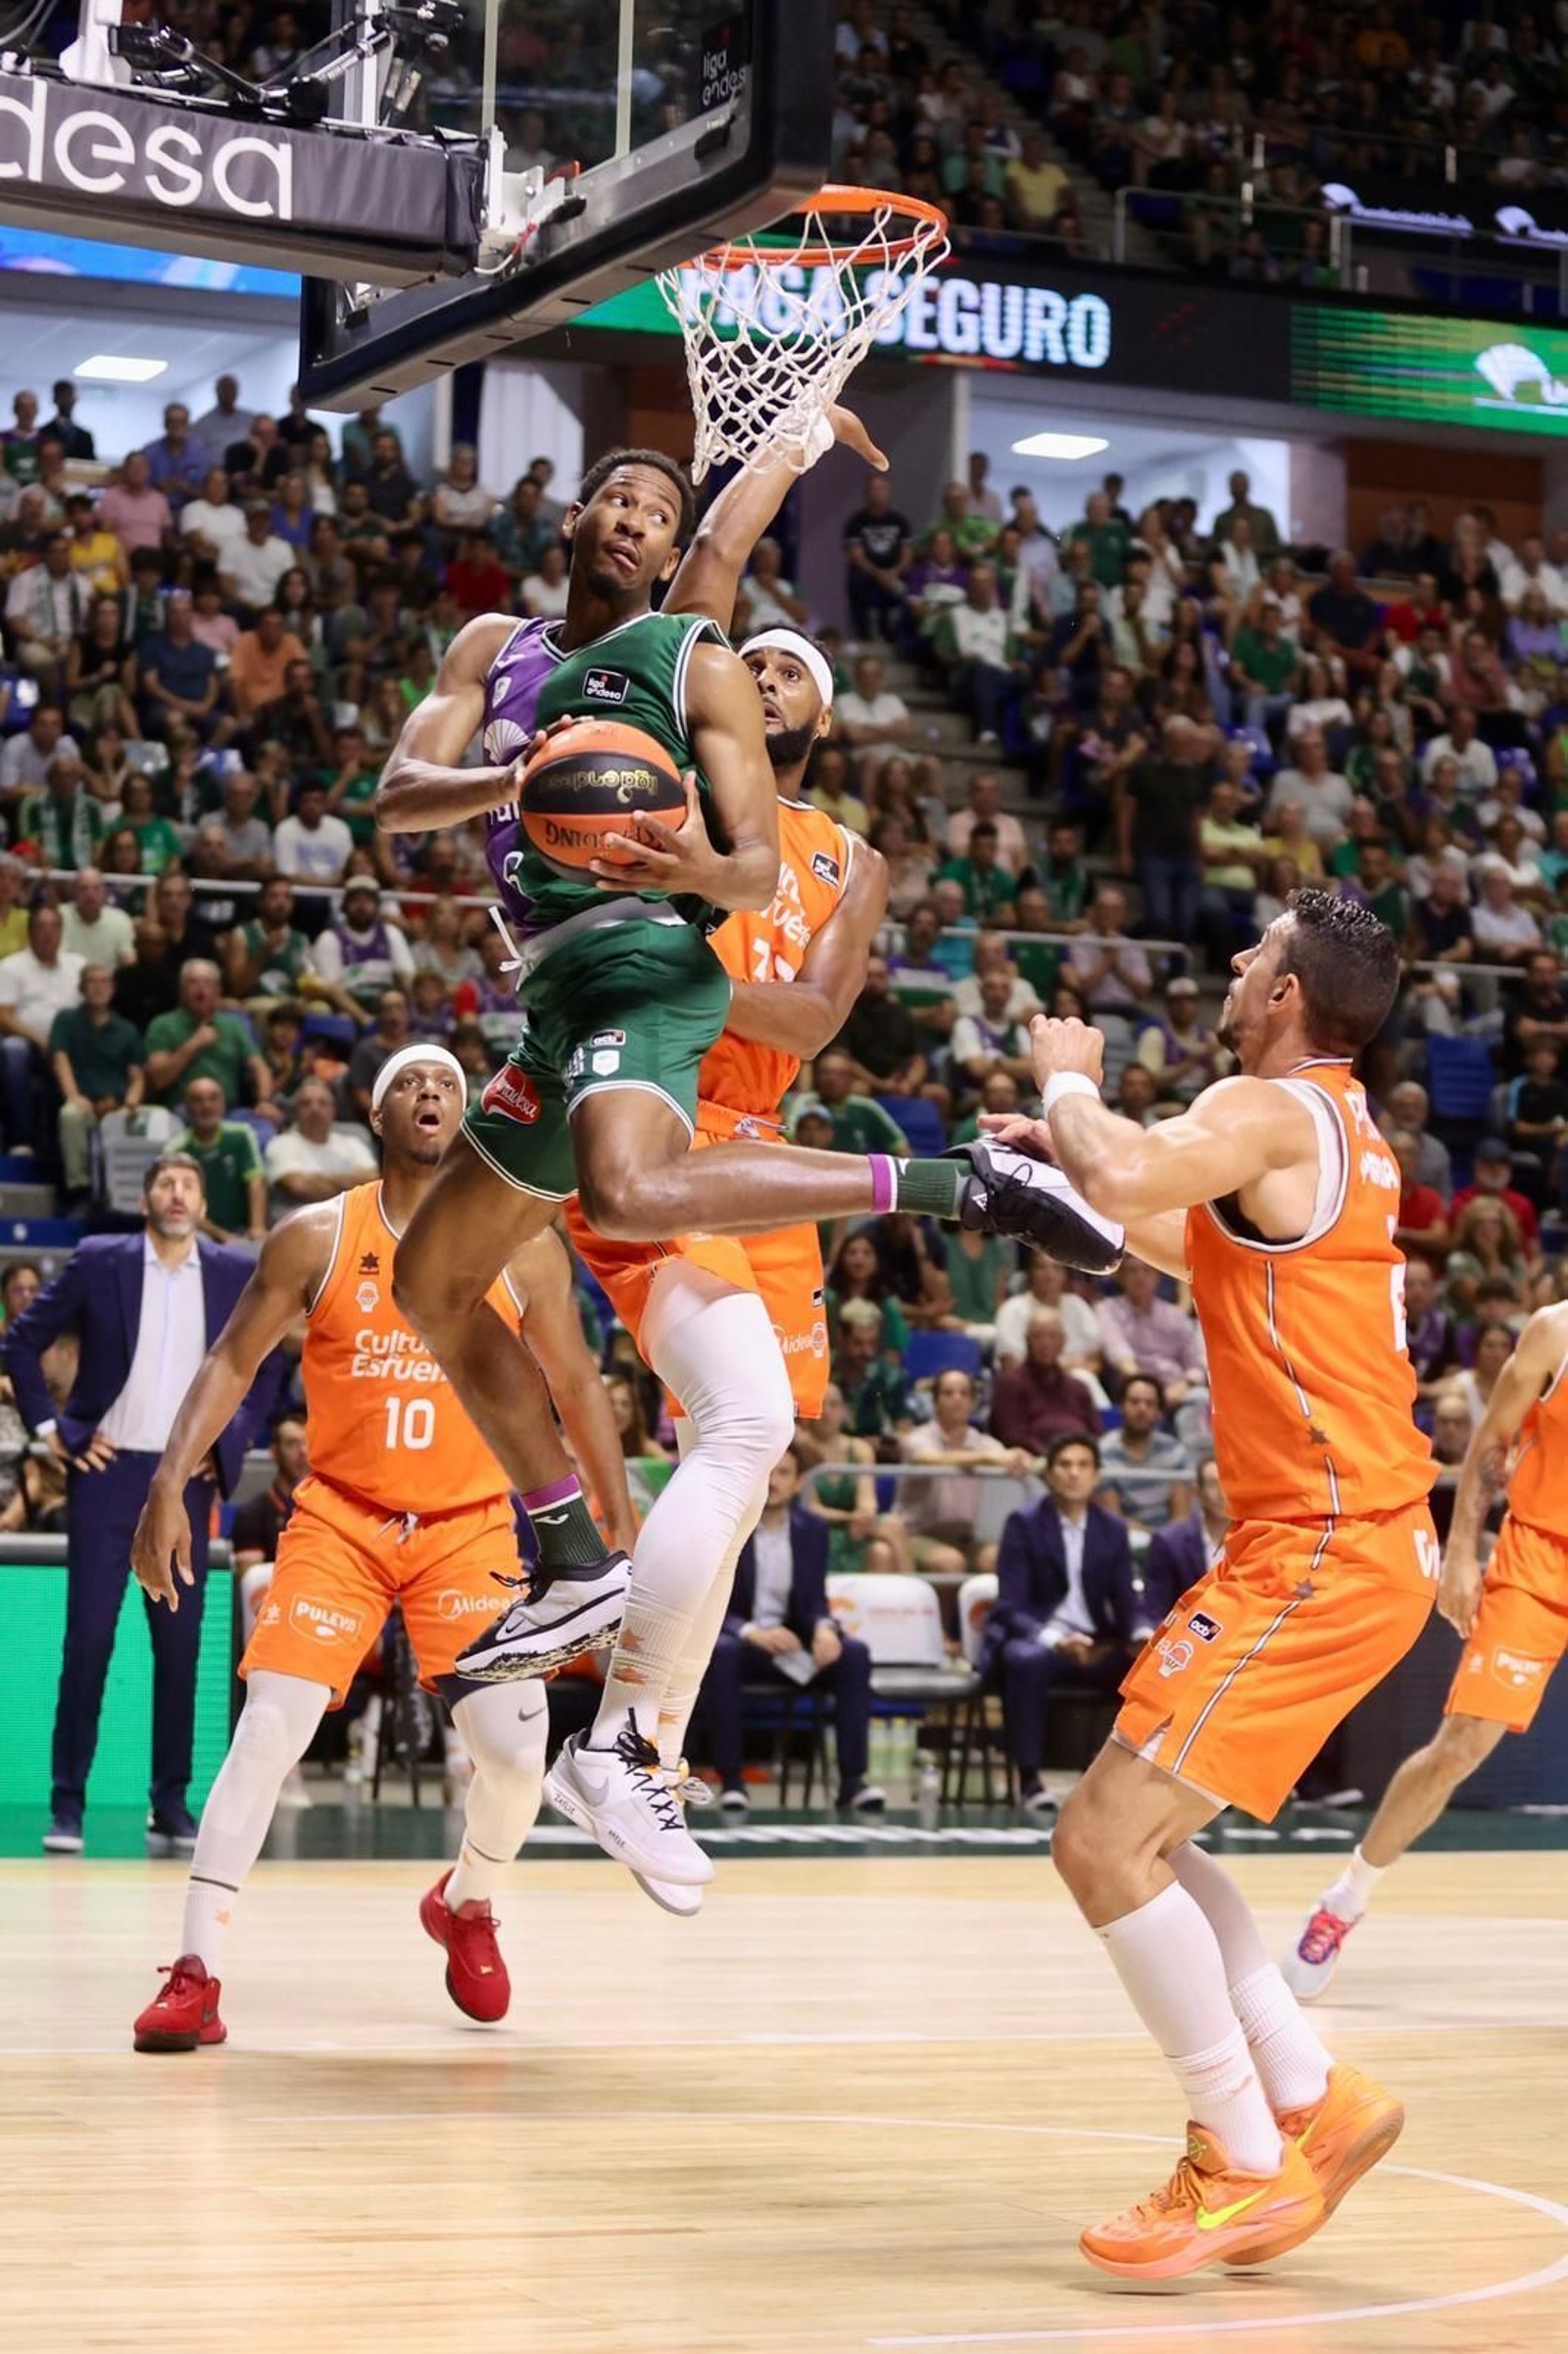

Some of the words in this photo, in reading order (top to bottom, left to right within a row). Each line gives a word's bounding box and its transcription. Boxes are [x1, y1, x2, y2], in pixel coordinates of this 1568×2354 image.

[703, 50, 727, 79] liga
[702, 66, 746, 106] endes
[864, 269, 1111, 368] SEGURO
[385, 1396, 436, 1449] 10
[296, 1600, 356, 1633] PULEVA
